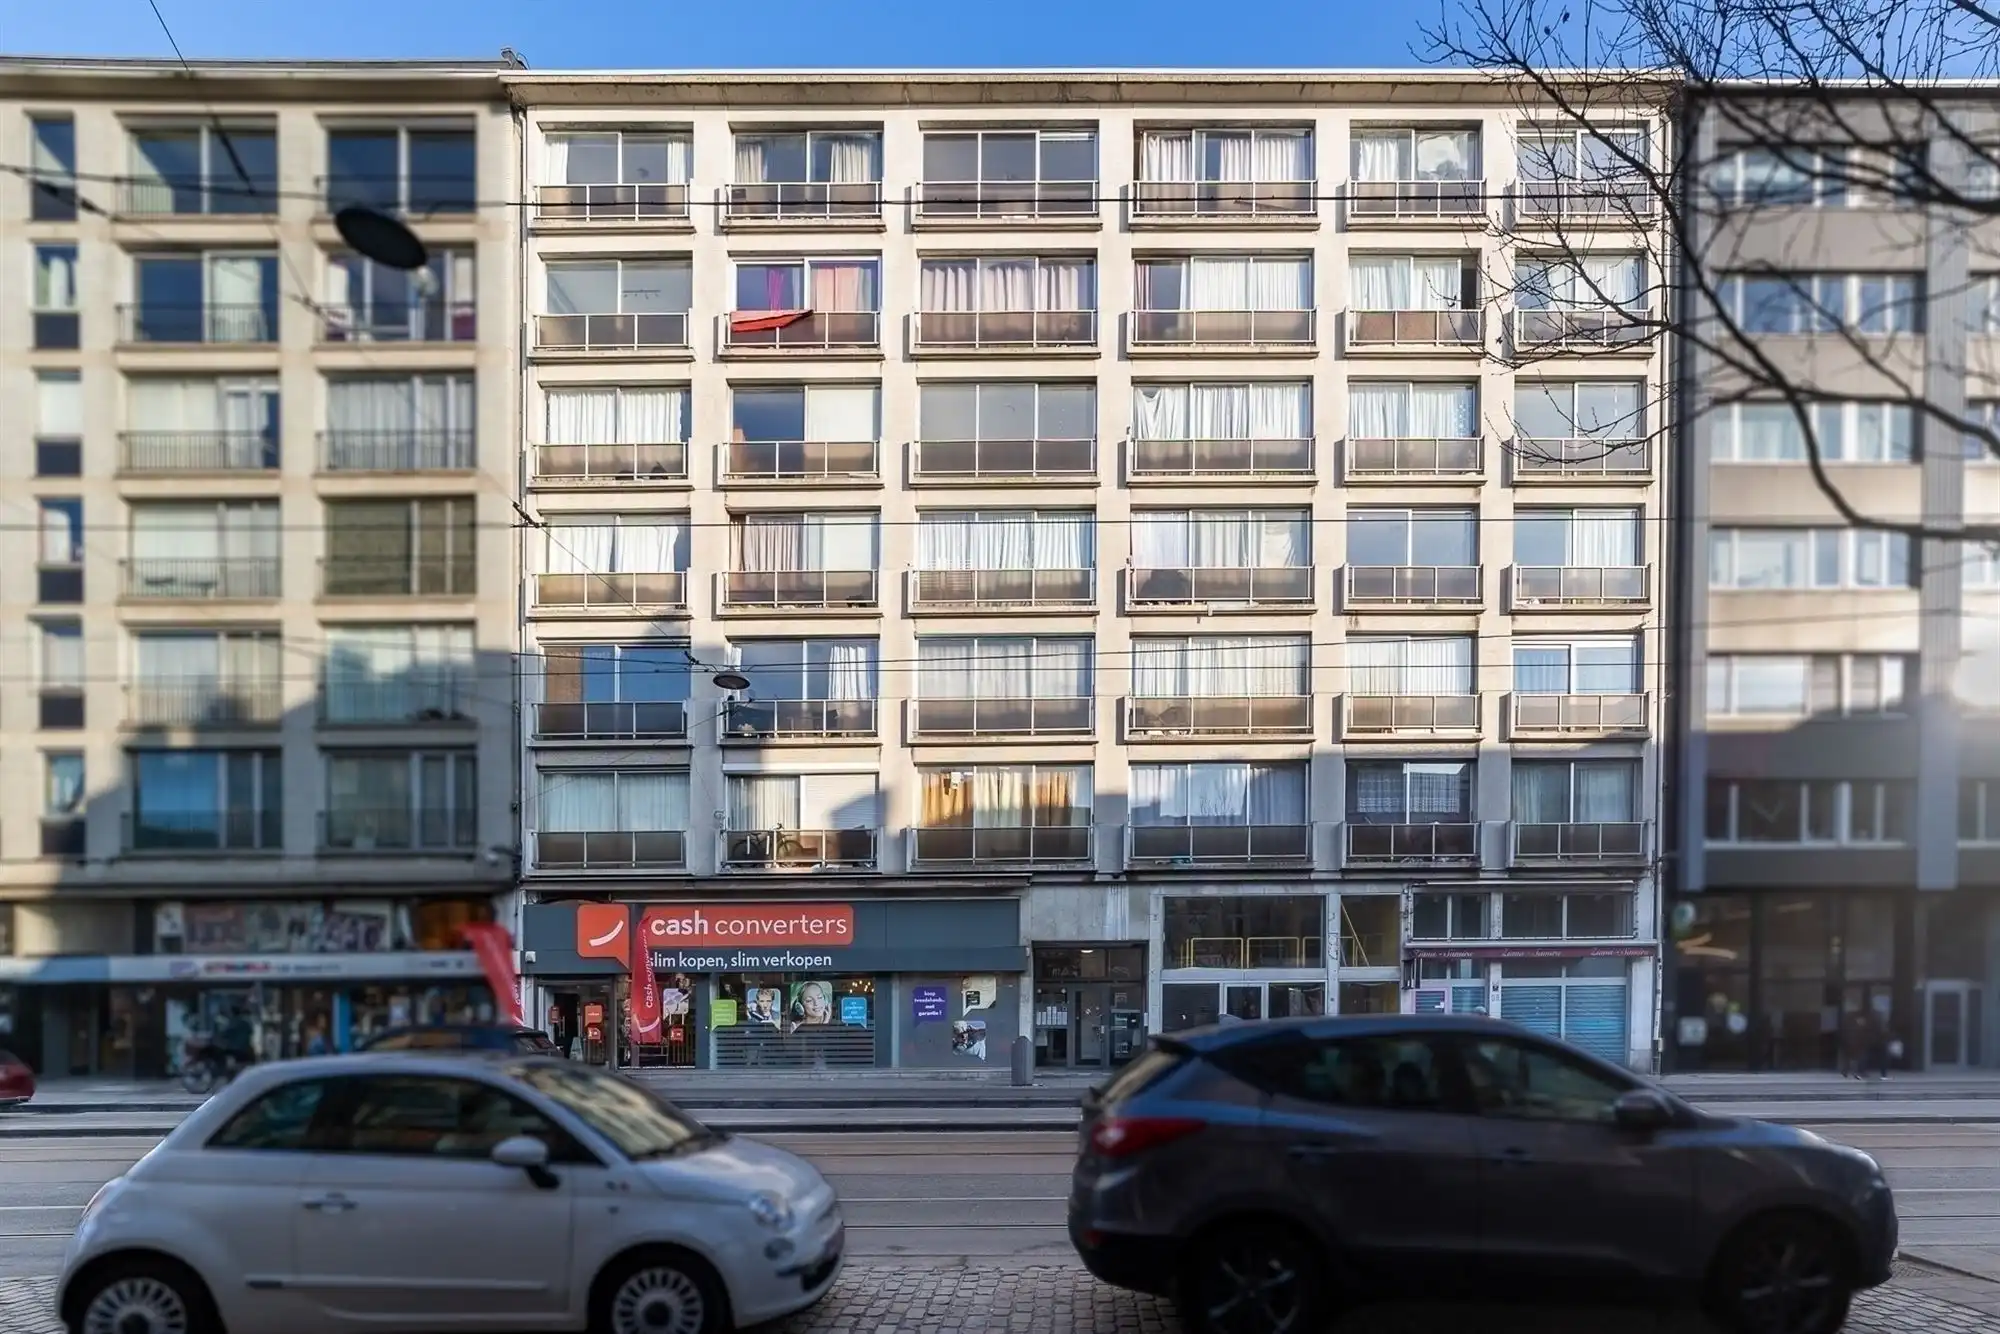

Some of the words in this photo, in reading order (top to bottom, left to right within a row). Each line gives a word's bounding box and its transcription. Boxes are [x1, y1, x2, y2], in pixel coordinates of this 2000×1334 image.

[651, 910, 708, 935] cash
[715, 914, 847, 935] converters
[679, 951, 728, 970] kopen,
[731, 951, 760, 967] slim
[762, 950, 832, 969] verkopen
[644, 984, 653, 1008] cash
